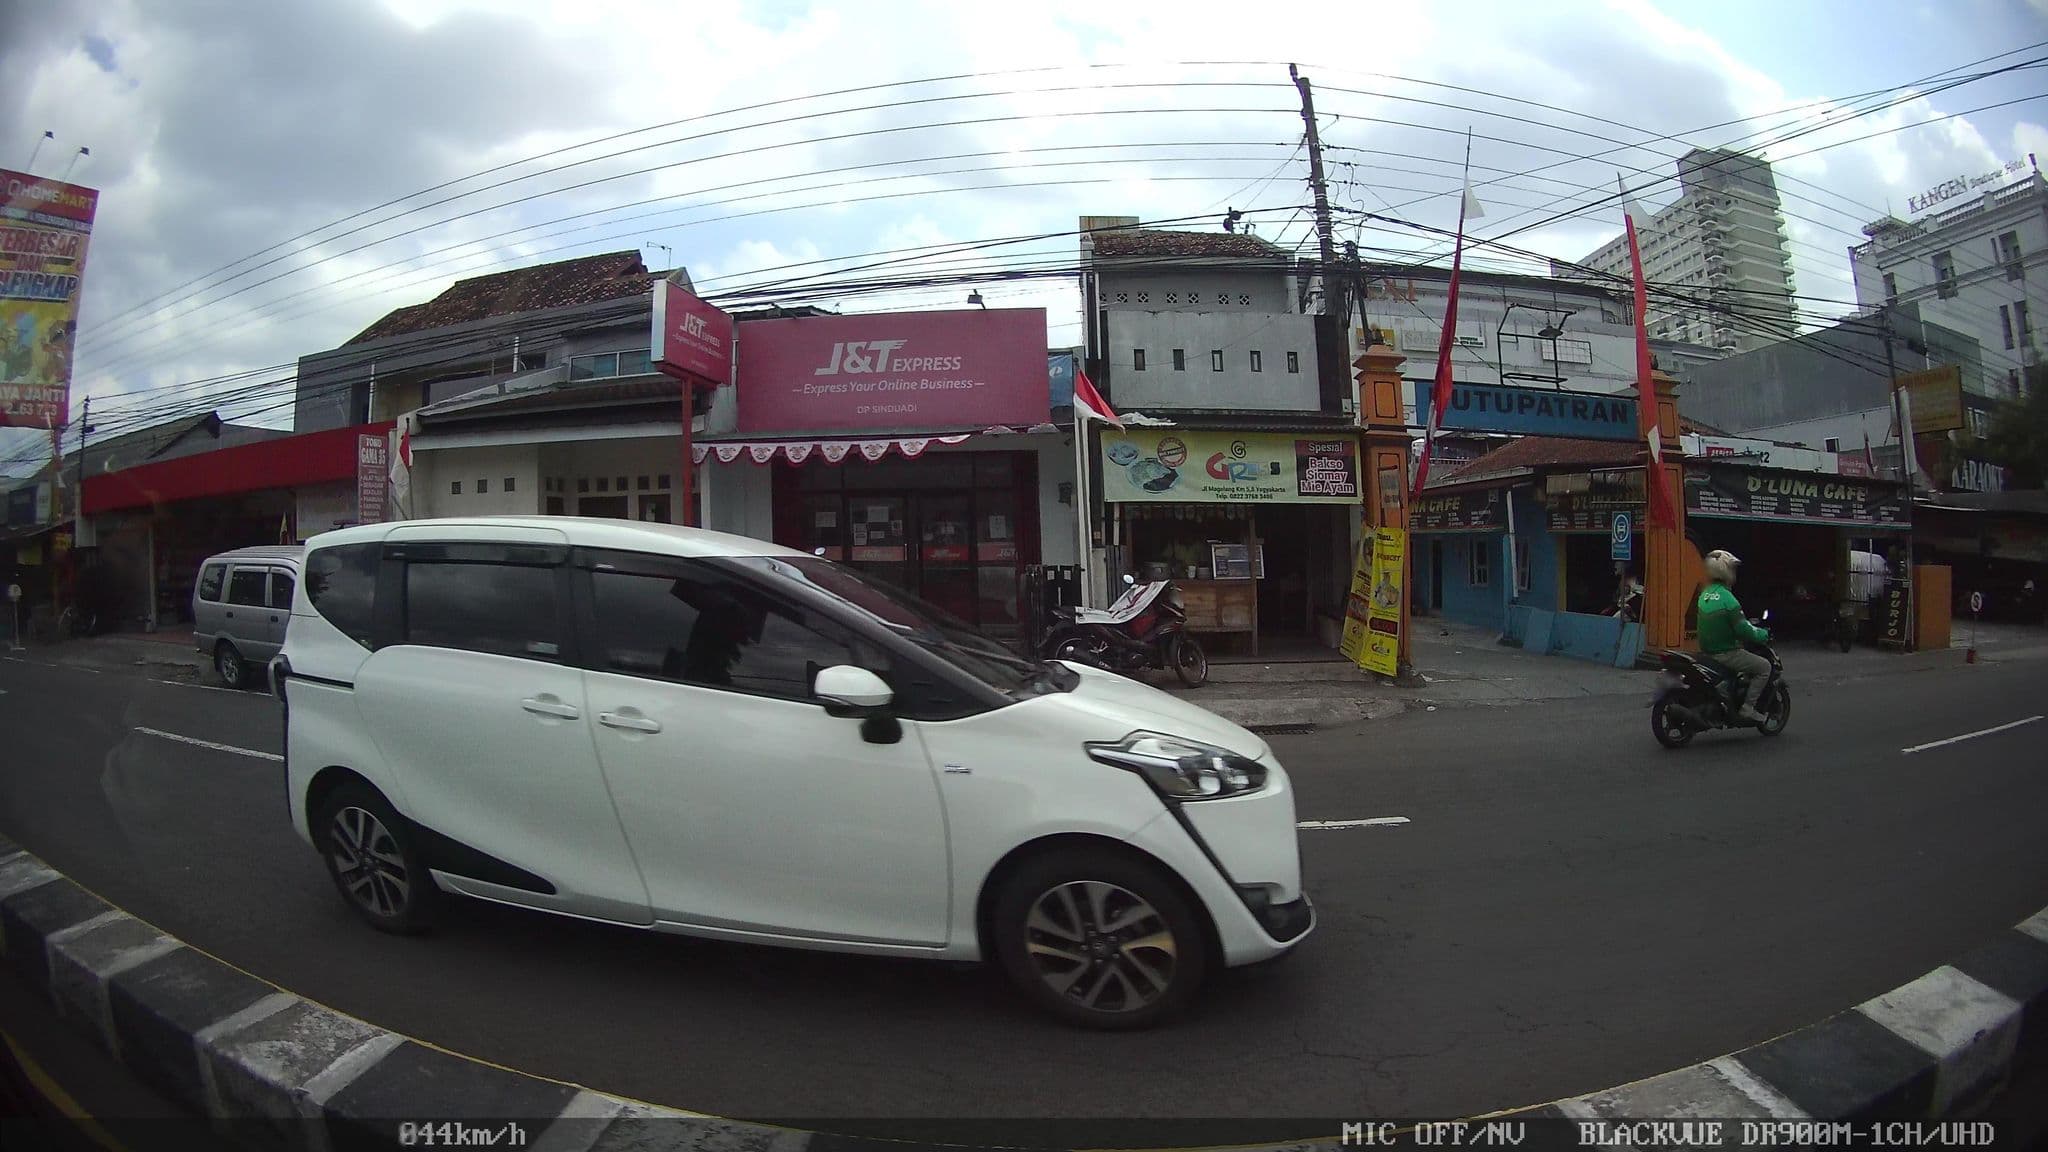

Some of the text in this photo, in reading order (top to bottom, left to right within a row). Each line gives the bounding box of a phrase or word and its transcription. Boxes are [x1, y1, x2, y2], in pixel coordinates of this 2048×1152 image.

[1908, 174, 1968, 214] KANGEN
[679, 312, 706, 338] J&T
[814, 339, 962, 376] J&T EXPRESS
[803, 378, 974, 396] Express Your Online Business
[857, 405, 870, 414] DP
[1428, 387, 1628, 424] UTUPATRAN
[1308, 442, 1343, 454] Spesial
[1309, 457, 1344, 470] Bakso
[1306, 469, 1348, 484] Siomay
[1301, 480, 1354, 495] Mie Ayam
[1747, 475, 1866, 502] D'LUNA CAFE
